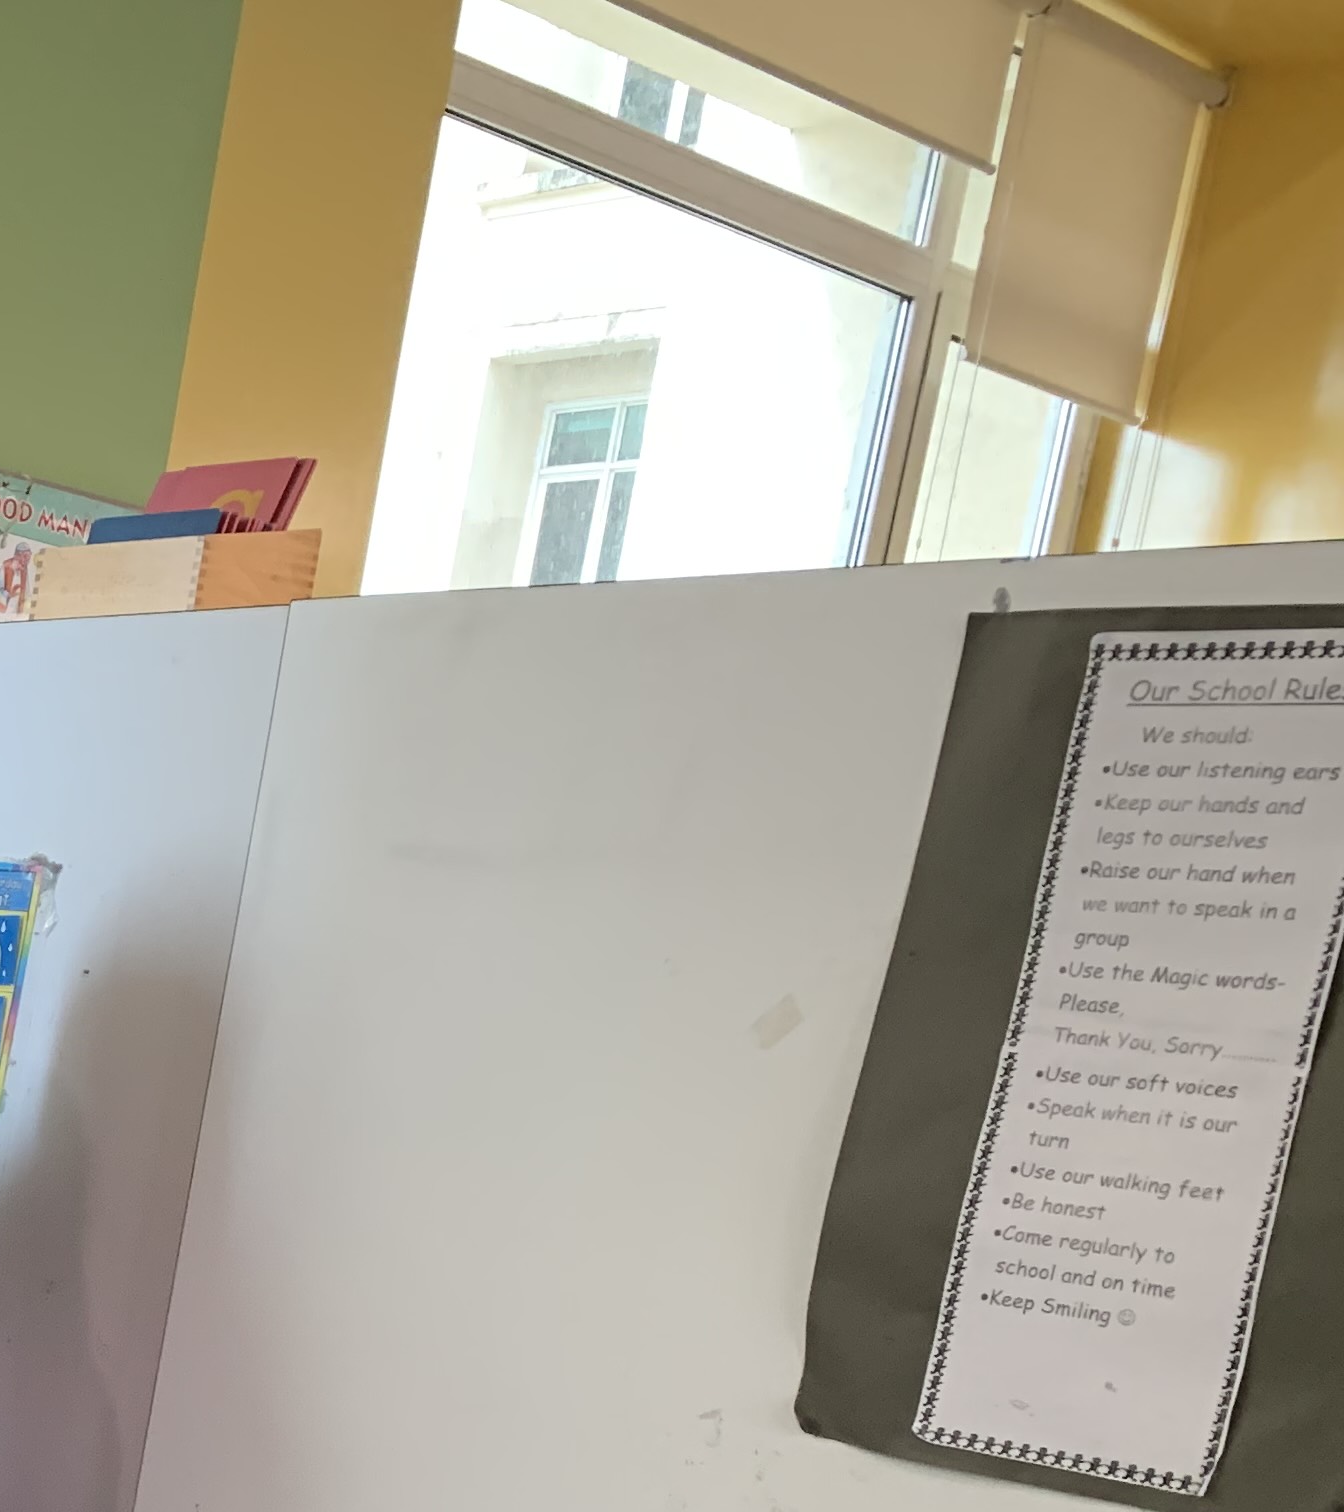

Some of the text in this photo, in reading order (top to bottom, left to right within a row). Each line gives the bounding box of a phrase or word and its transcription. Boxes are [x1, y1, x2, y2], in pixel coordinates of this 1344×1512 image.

[38, 509, 88, 538] MAN
[1129, 677, 1344, 702] Our School Rule
[1142, 726, 1174, 743] We
[1112, 761, 1341, 784] Use our listening ears
[1104, 794, 1306, 816] Keep our hands and
[1097, 828, 1268, 850] legs to ourselves
[1090, 861, 1295, 885] Raise our hand when
[1083, 899, 1296, 921] we want to speak in a
[1074, 932, 1130, 951] group
[1068, 961, 1104, 979] Use
[1112, 964, 1144, 982] the
[1150, 966, 1209, 990] Magic
[1059, 993, 1125, 1018] Please,
[1056, 1027, 1110, 1048] Thank
[1046, 1066, 1238, 1099] Use our soft voices
[1037, 1098, 1238, 1134] Speak when it is our
[1028, 1132, 1070, 1149] turn
[1020, 1161, 1225, 1201] Use our walking feet
[1012, 1192, 1106, 1220] Be honest
[1002, 1225, 1175, 1265] Come regularly to
[995, 1259, 1175, 1299] school and on time
[989, 1289, 1111, 1327] Keep Smiling
